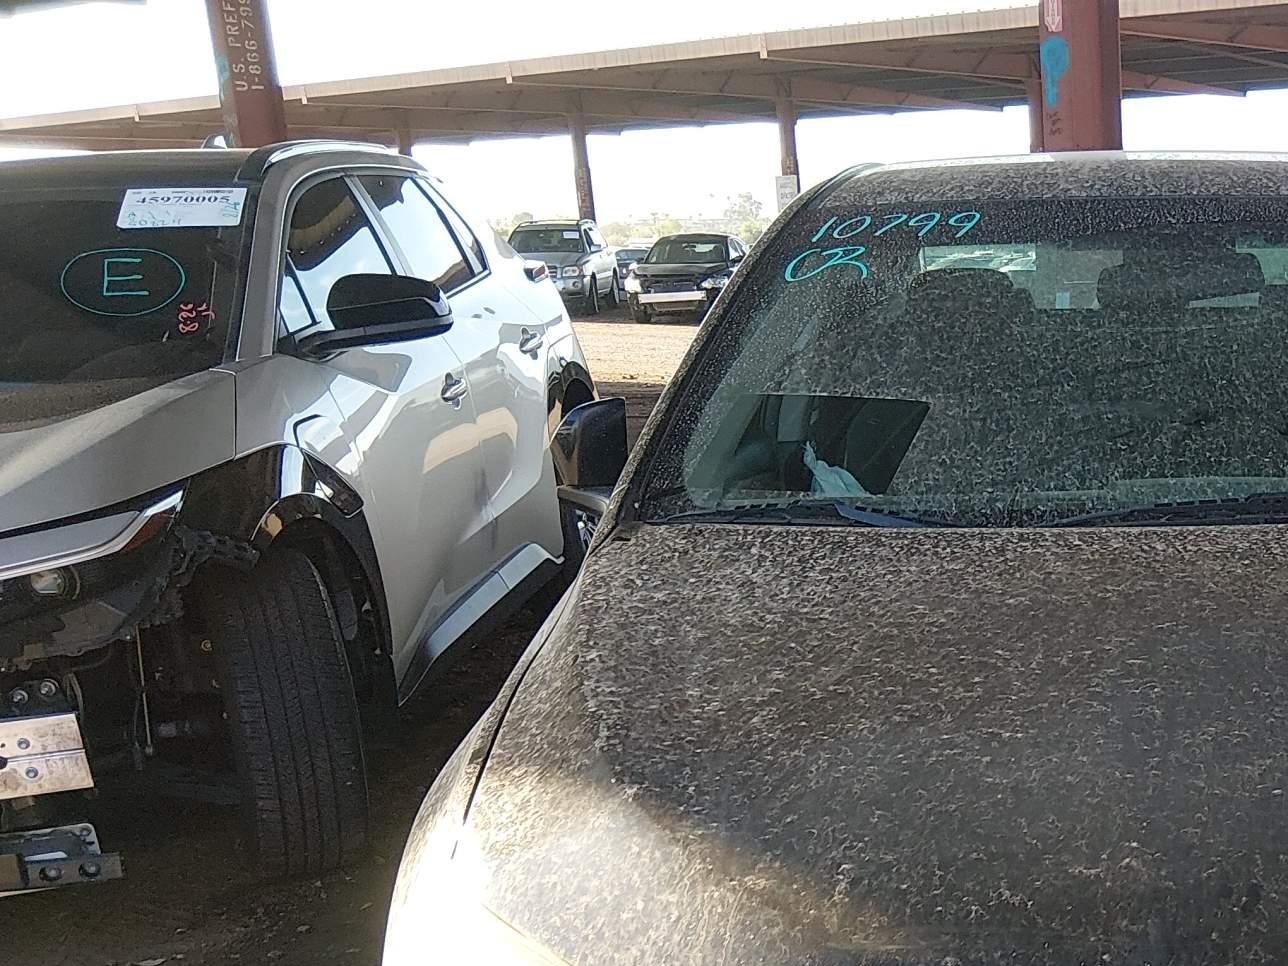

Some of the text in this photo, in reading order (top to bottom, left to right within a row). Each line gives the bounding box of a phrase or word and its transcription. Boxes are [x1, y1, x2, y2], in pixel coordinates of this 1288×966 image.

[232, 57, 249, 91] U.S.
[135, 195, 231, 204] 45970005
[811, 212, 981, 242] 10799
[103, 257, 149, 296] E
